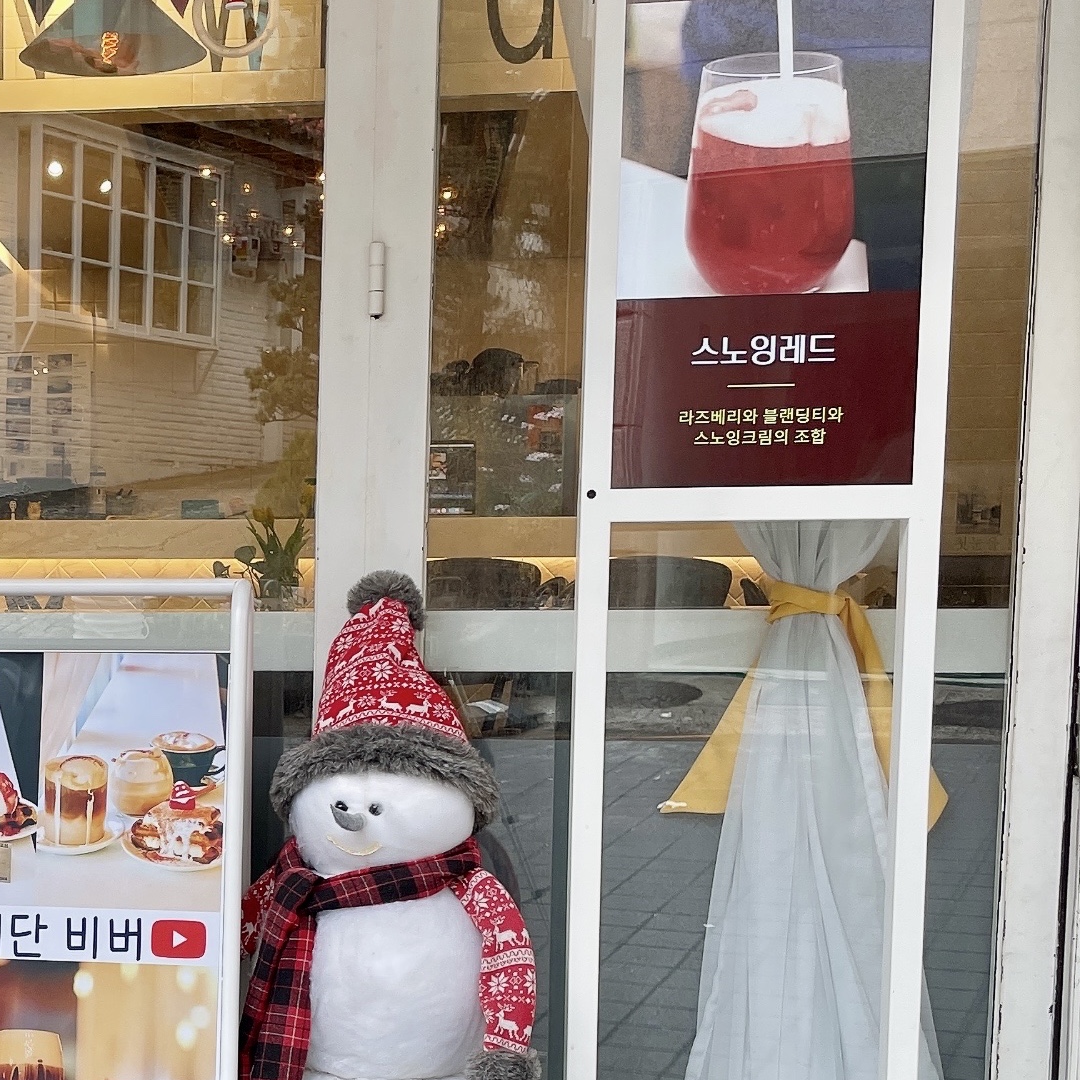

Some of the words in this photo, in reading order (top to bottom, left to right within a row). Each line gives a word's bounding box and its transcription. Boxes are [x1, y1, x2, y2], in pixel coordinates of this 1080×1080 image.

[690, 333, 837, 366] 스노잉레드
[678, 408, 759, 426] 라즈베리와
[762, 406, 845, 425] 블랜딩티와
[693, 428, 790, 446] 스노잉크림의
[793, 427, 827, 445] 조합
[66, 916, 142, 961] 비버
